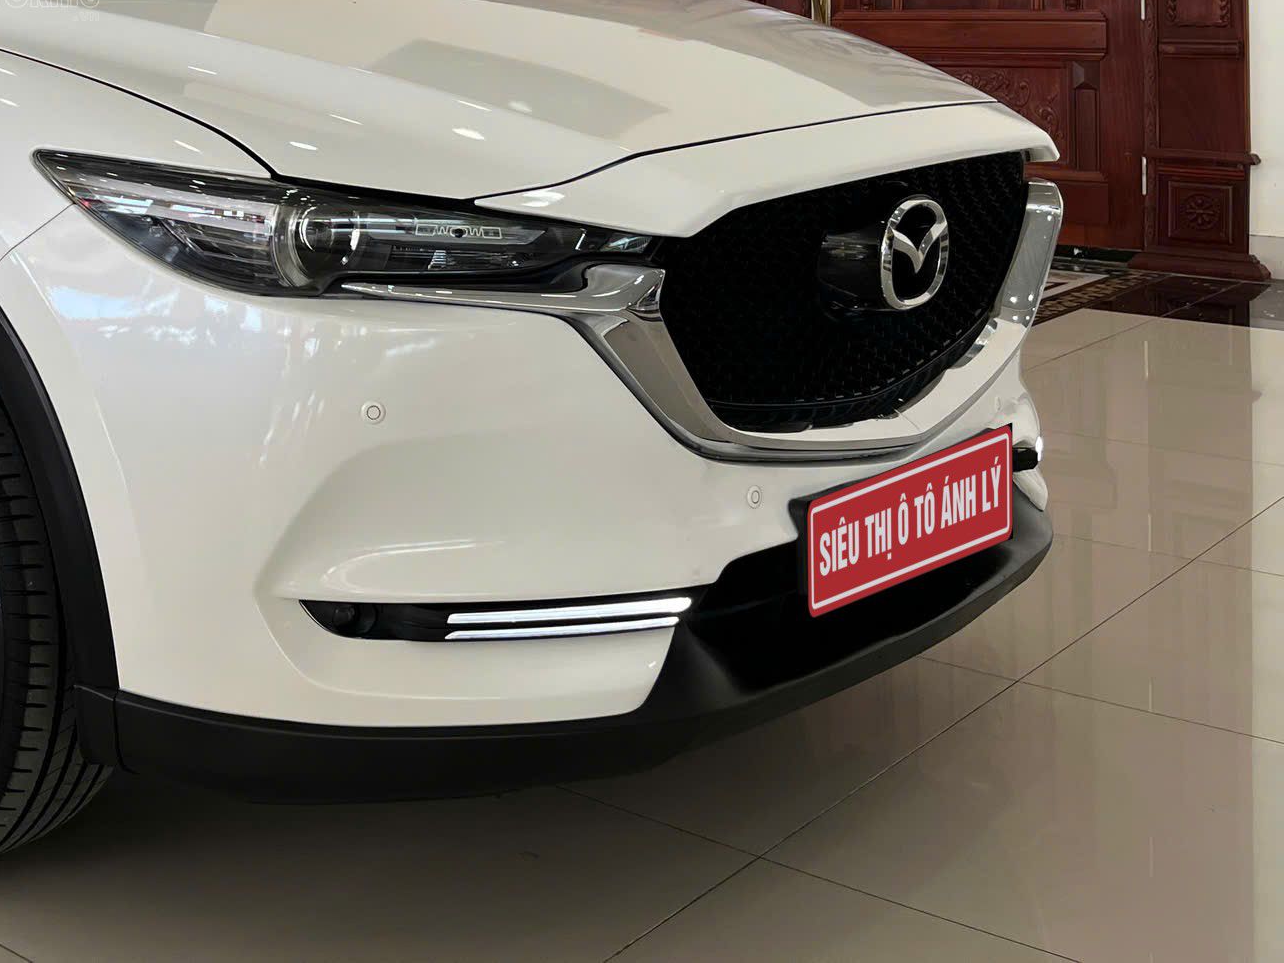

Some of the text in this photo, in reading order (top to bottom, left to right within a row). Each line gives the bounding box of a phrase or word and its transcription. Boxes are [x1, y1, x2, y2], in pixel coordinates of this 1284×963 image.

[818, 456, 1002, 577] SIÊU THỊ Ô TÔ ÁNH LÝ
